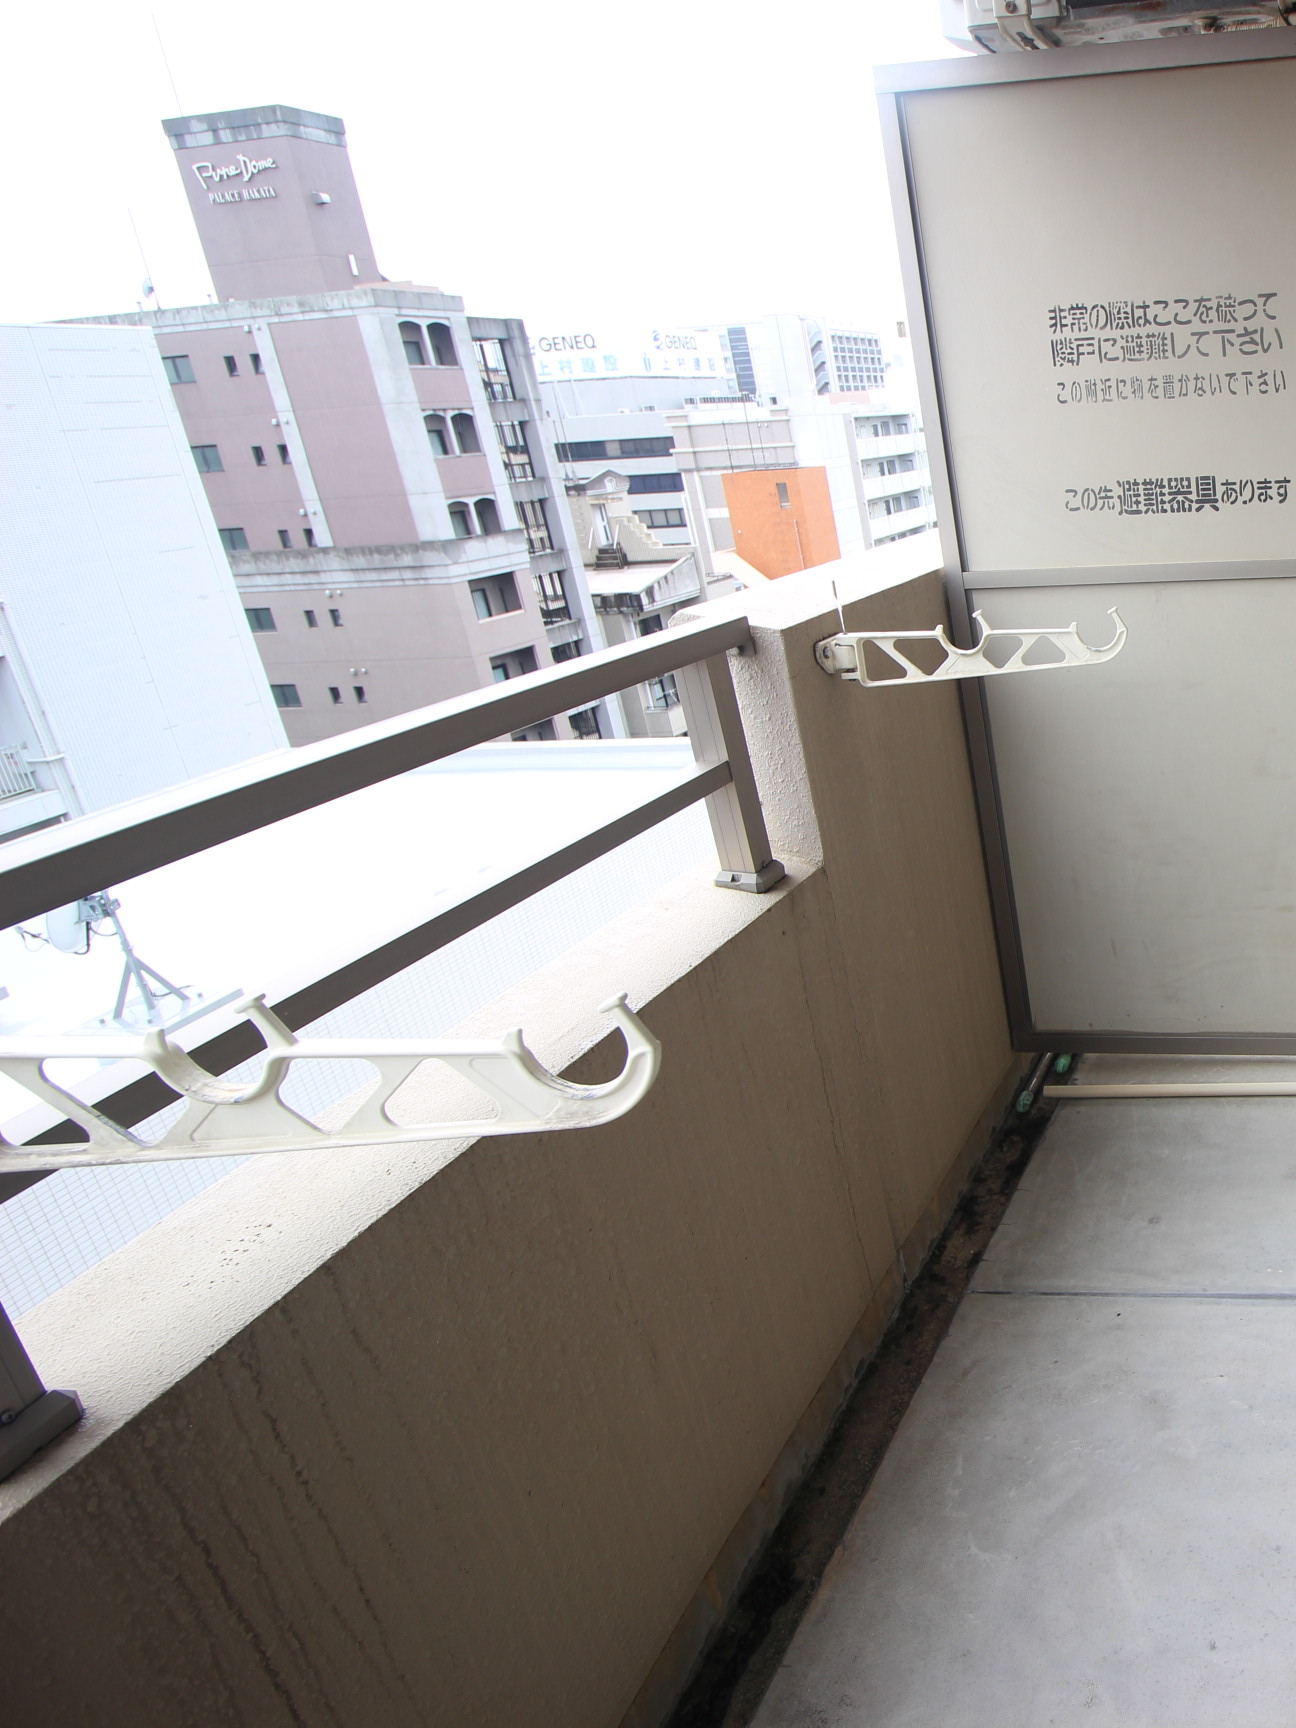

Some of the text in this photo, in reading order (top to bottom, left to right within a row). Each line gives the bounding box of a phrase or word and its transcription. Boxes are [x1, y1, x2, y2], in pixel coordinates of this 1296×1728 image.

[236, 153, 276, 182] Dome
[208, 185, 276, 204] PALACE HAKATA
[1048, 293, 1278, 334] 非常の際はここを破って
[538, 333, 597, 352] GENEQ
[664, 334, 698, 350] GENEQ
[1051, 326, 1284, 367] 隣戸に避難して下さい
[1056, 369, 1287, 404] この附近に物を置かないで下さい
[1065, 475, 1292, 516] この先避難器具あります
